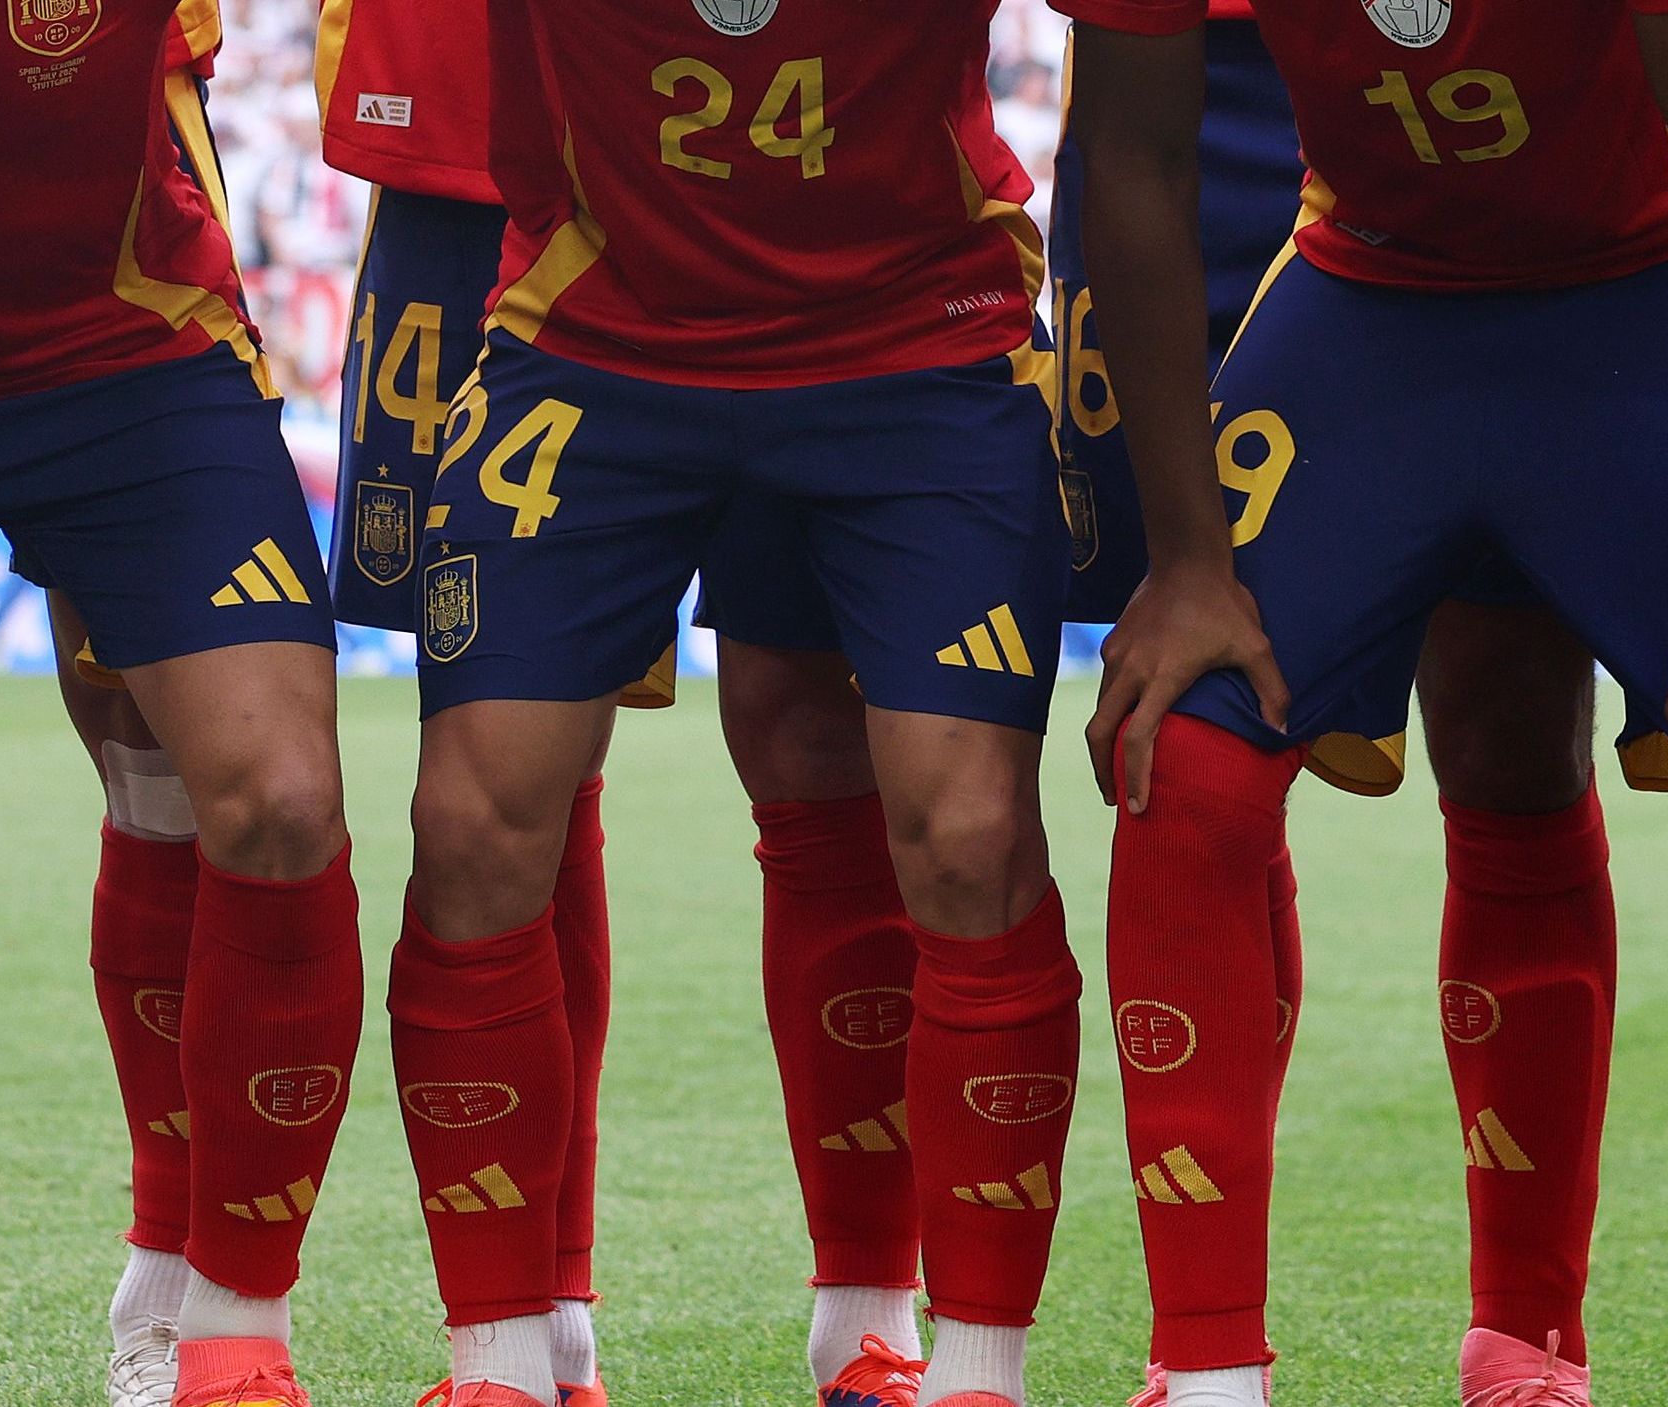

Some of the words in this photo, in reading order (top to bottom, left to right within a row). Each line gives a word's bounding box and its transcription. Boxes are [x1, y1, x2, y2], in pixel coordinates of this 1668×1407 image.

[712, 19, 742, 32] WINNER
[650, 55, 835, 180] 24
[1363, 68, 1530, 164] 19
[945, 290, 1006, 318] HEAT.RDY
[355, 291, 449, 456] 14
[425, 385, 583, 539] 24
[1212, 401, 1296, 548] 9
